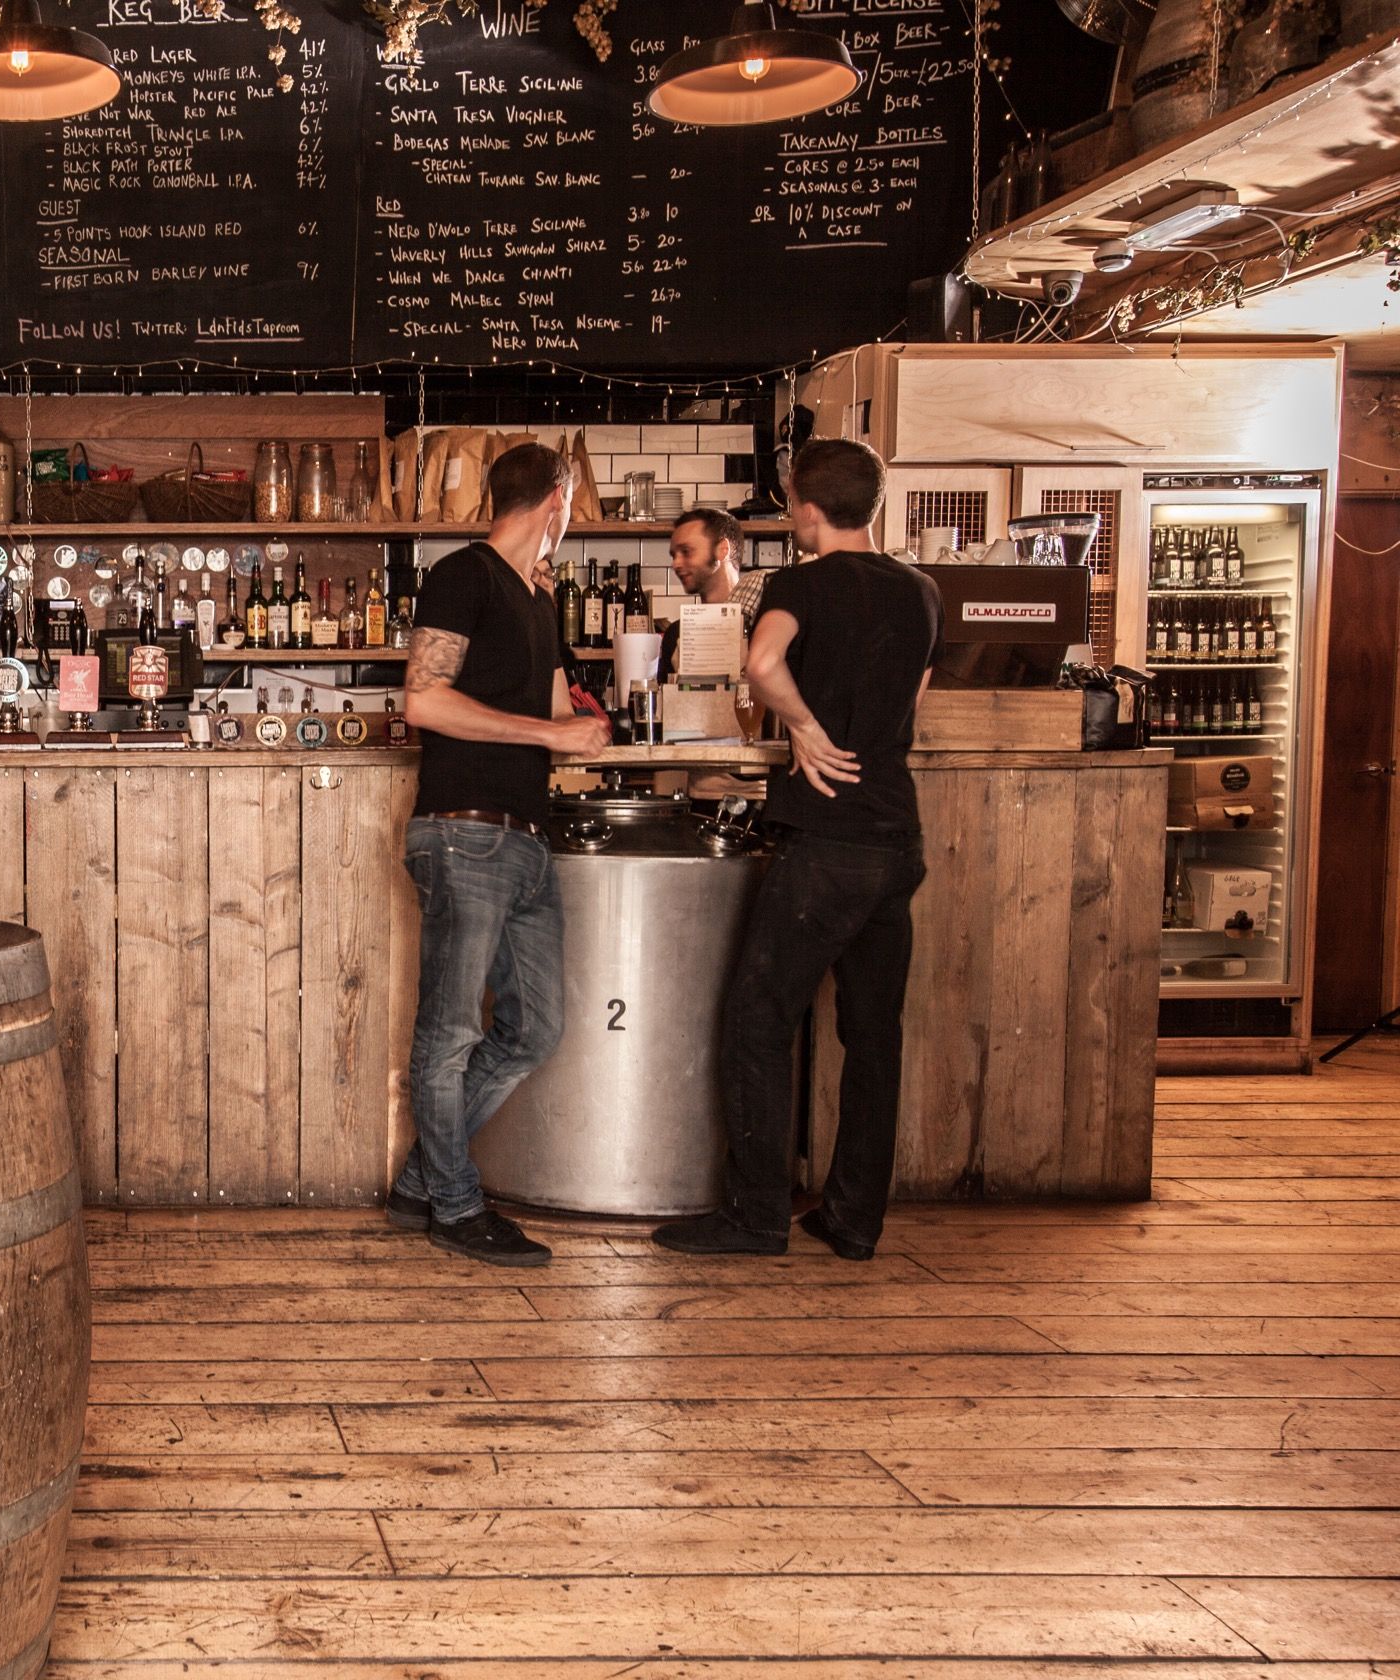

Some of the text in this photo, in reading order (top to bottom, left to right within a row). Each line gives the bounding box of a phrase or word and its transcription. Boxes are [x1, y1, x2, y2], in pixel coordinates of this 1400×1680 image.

[109, 0, 152, 25] KEG
[481, 0, 543, 39] WINE
[151, 46, 196, 64] LAGER
[630, 39, 664, 56] GLASS
[194, 67, 230, 82] WHITE
[455, 71, 507, 95] TERRE
[130, 86, 273, 103] HOPSTER PACIFIC PALE
[99, 106, 120, 120] NOT
[128, 104, 154, 121] WAR
[185, 106, 205, 119] RED
[217, 105, 236, 117] ALE
[391, 106, 437, 125] SANTA
[454, 106, 494, 123] TRESA
[63, 123, 210, 144] SHOREDITCH TRIANGLE
[394, 129, 595, 152] BODEGAS MENADE BLANC
[780, 126, 943, 152] TAKEAWAY BOTTLES
[64, 141, 193, 157] BLACK FROST STOUT
[64, 158, 192, 173] BLACK PATH PORTER
[785, 160, 828, 176] CORES
[892, 156, 919, 169] EACH
[63, 174, 140, 192] MAGIC ROCK
[426, 173, 471, 184] CHATEAU
[565, 173, 600, 187] BLANC
[779, 182, 848, 195] SEASONALS
[891, 178, 916, 188] EACH
[39, 199, 81, 216] GUEST
[822, 203, 882, 221] DISCOUNT
[897, 198, 911, 211] ON
[67, 222, 241, 242] POINTS HOOK ISLAND RED
[389, 223, 419, 239] NERO
[483, 220, 517, 237] TERRE
[828, 225, 860, 236] CASE
[39, 246, 129, 265] SEASONAL
[391, 246, 445, 264] WAVERLY
[460, 245, 492, 259] HILLS
[566, 239, 606, 253] SHIRAZ
[55, 264, 249, 289] FIRST BORN BARLEY WINE
[389, 271, 421, 284] WHEN
[433, 271, 451, 283] WE
[466, 269, 504, 285] DANCE
[388, 292, 553, 309] COSMO MALBEC SYRAH
[18, 319, 84, 343] FOLLOW
[483, 315, 563, 333] SANTA TRESA
[492, 331, 526, 350] NERO
[968, 607, 1051, 617] LA MARZOCCO
[607, 999, 626, 1030] 2
